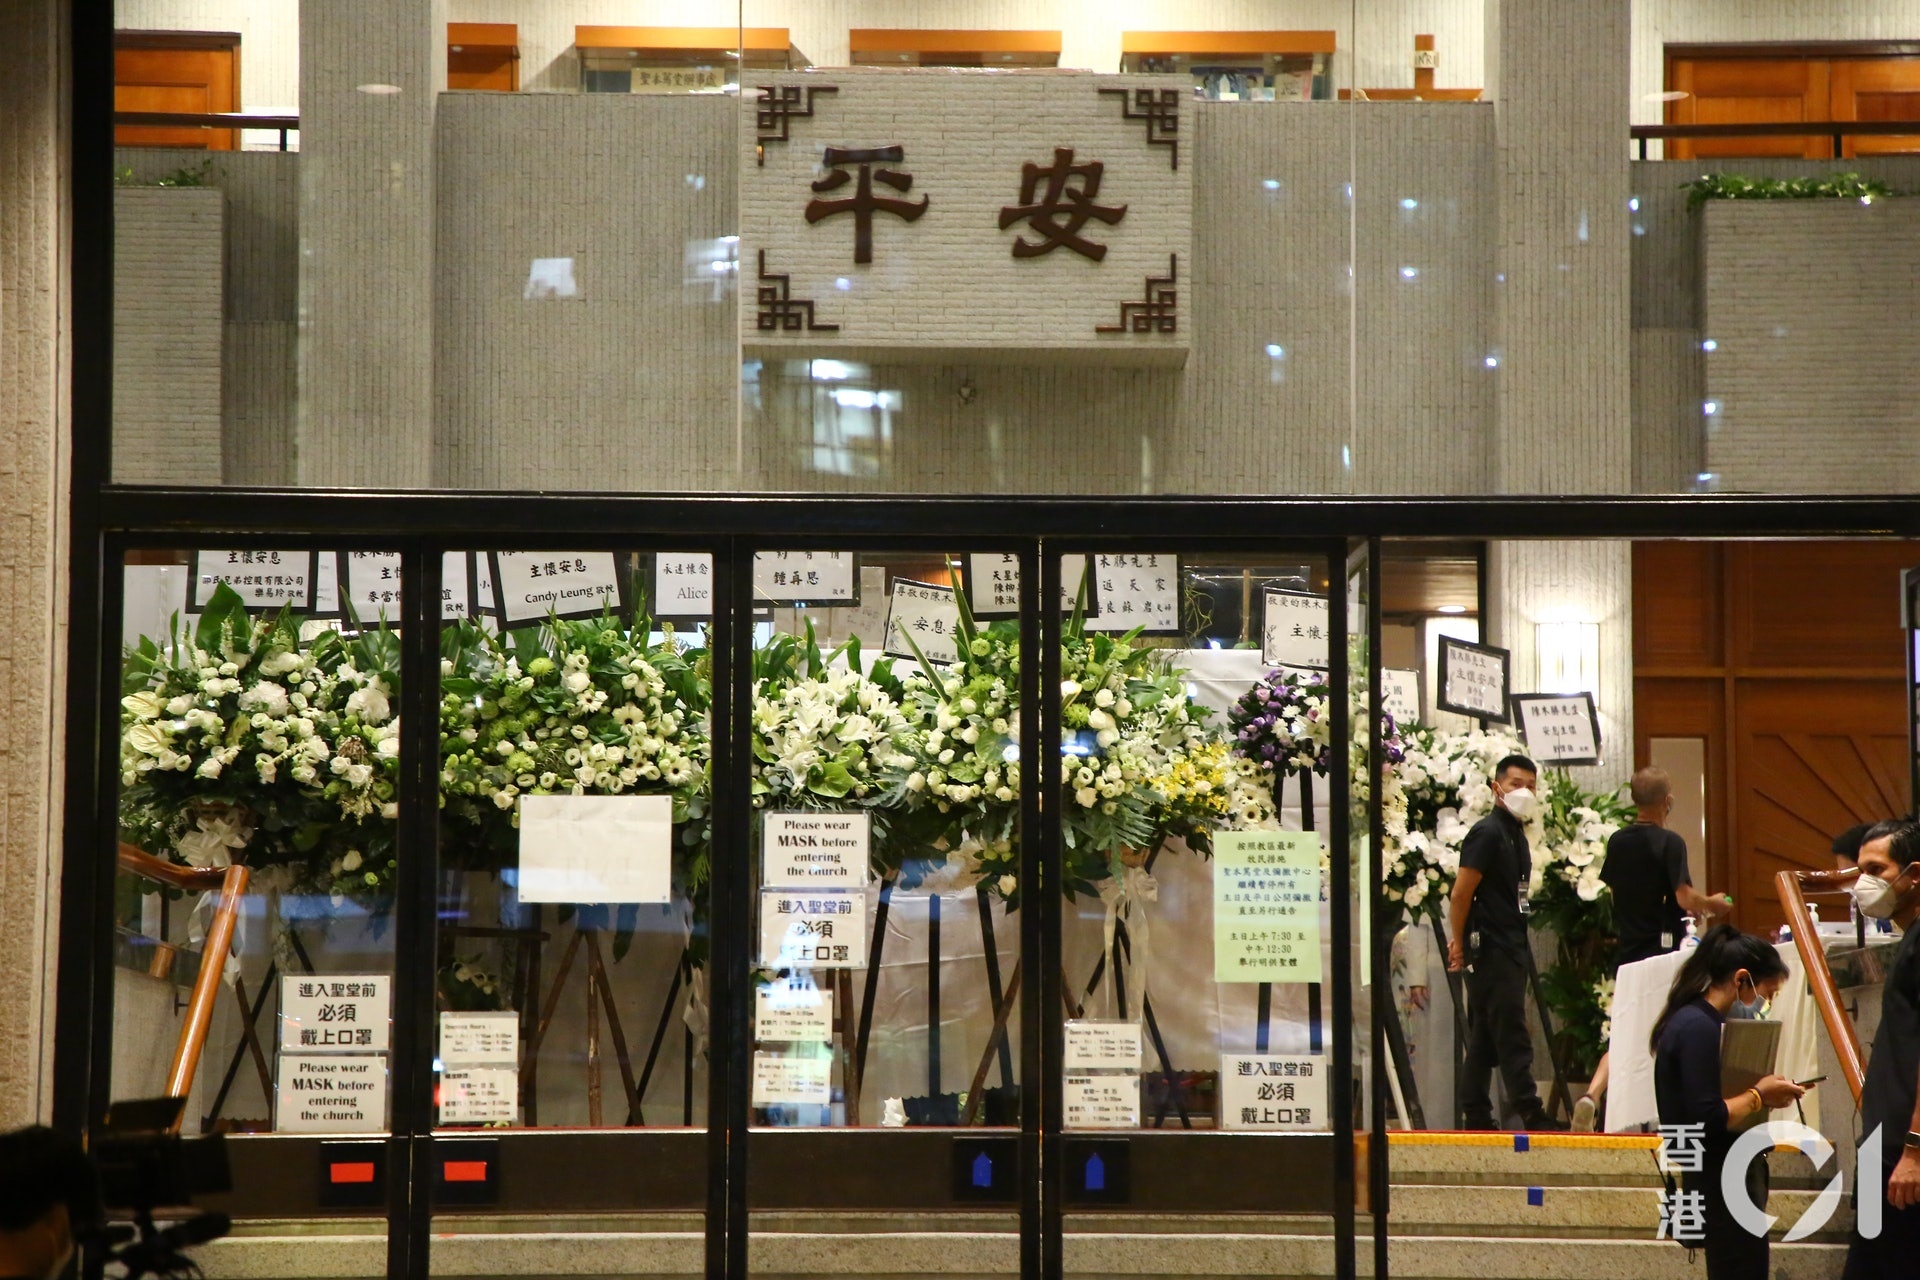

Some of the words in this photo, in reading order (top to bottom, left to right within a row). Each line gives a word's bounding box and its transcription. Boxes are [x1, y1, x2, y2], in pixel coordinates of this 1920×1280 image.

[805, 143, 1128, 264] 平安
[227, 550, 281, 565] 主懷安息
[530, 558, 587, 578] 主懷安息
[663, 563, 709, 575] 永遠懷念
[524, 591, 558, 604] Candy
[560, 586, 594, 598] Leung
[677, 586, 709, 599] Alice
[896, 584, 957, 604] 尊敬的陳木
[784, 820, 821, 831] Please
[824, 822, 851, 831] wear
[777, 835, 818, 848] MASK
[822, 837, 857, 848] before
[1236, 841, 1296, 851] 按照教區最新
[794, 852, 841, 864] entering
[787, 866, 805, 876] the
[808, 866, 848, 876] church
[1223, 867, 1312, 877] 聖本篤堂及彌撒中心
[1237, 880, 1297, 890] 繼續暫停所有
[1223, 893, 1312, 902] 主日及平日公開彌撒
[777, 900, 852, 915] 進入聖堂前
[799, 920, 833, 938] 必須
[1230, 932, 1269, 941] 主日上午
[1272, 932, 1292, 941] 7:30
[1297, 932, 1306, 941] 至
[793, 945, 849, 962] 上口罩
[1245, 944, 1264, 954] 中午
[1267, 944, 1292, 954] 12:30
[1238, 957, 1298, 967] 舉行明供聖體
[298, 982, 376, 998] 進入聖堂前
[317, 1003, 357, 1022] 必須
[300, 1028, 372, 1046] 戴上口罩
[299, 1062, 337, 1073] Please
[341, 1064, 369, 1073] wear
[1238, 1061, 1314, 1077] 進入聖堂前
[292, 1077, 334, 1091] MASK
[337, 1080, 375, 1091] before
[1257, 1082, 1295, 1101] 必須
[308, 1096, 357, 1108] entering
[300, 1110, 320, 1121] the
[322, 1110, 364, 1121] church
[1241, 1107, 1311, 1124] 戴上口罩
